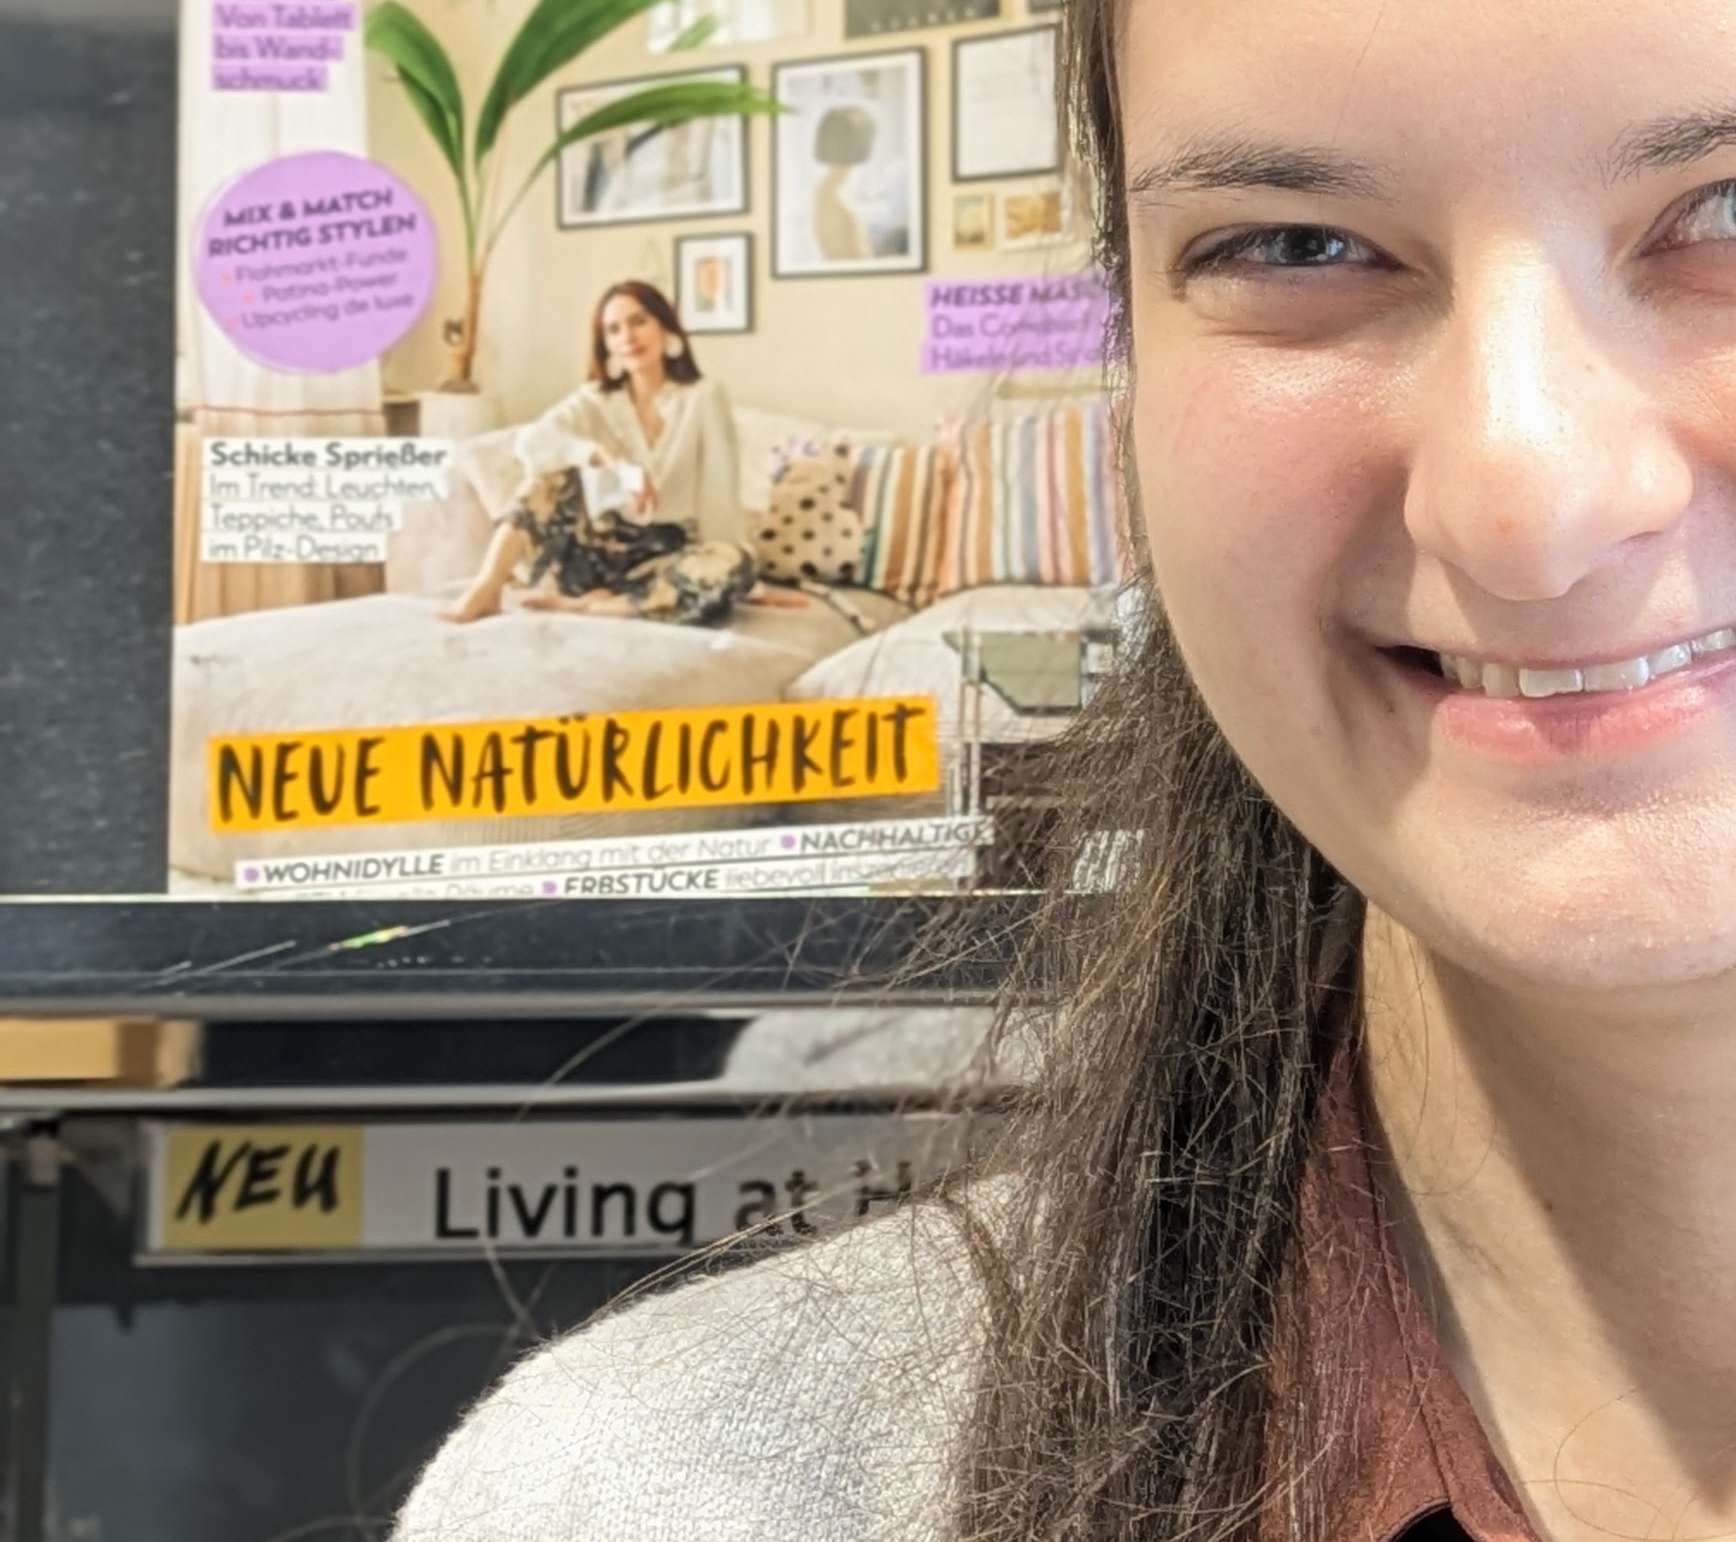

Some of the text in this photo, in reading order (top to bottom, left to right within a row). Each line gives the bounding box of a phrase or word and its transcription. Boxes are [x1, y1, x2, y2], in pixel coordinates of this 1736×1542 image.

[223, 203, 273, 228] MIX
[303, 188, 393, 218] MATCH
[208, 212, 416, 257] RICHTIG STYLEN
[930, 284, 1024, 307] HEISSE
[210, 441, 447, 471] Schicke Sprießer
[217, 703, 927, 822] NEUE NATÜRLICHKEIT
[264, 853, 444, 884] WOHNIDYLLE
[174, 1134, 341, 1224] NEU
[433, 1165, 695, 1243] Living
[734, 1170, 819, 1236] at
